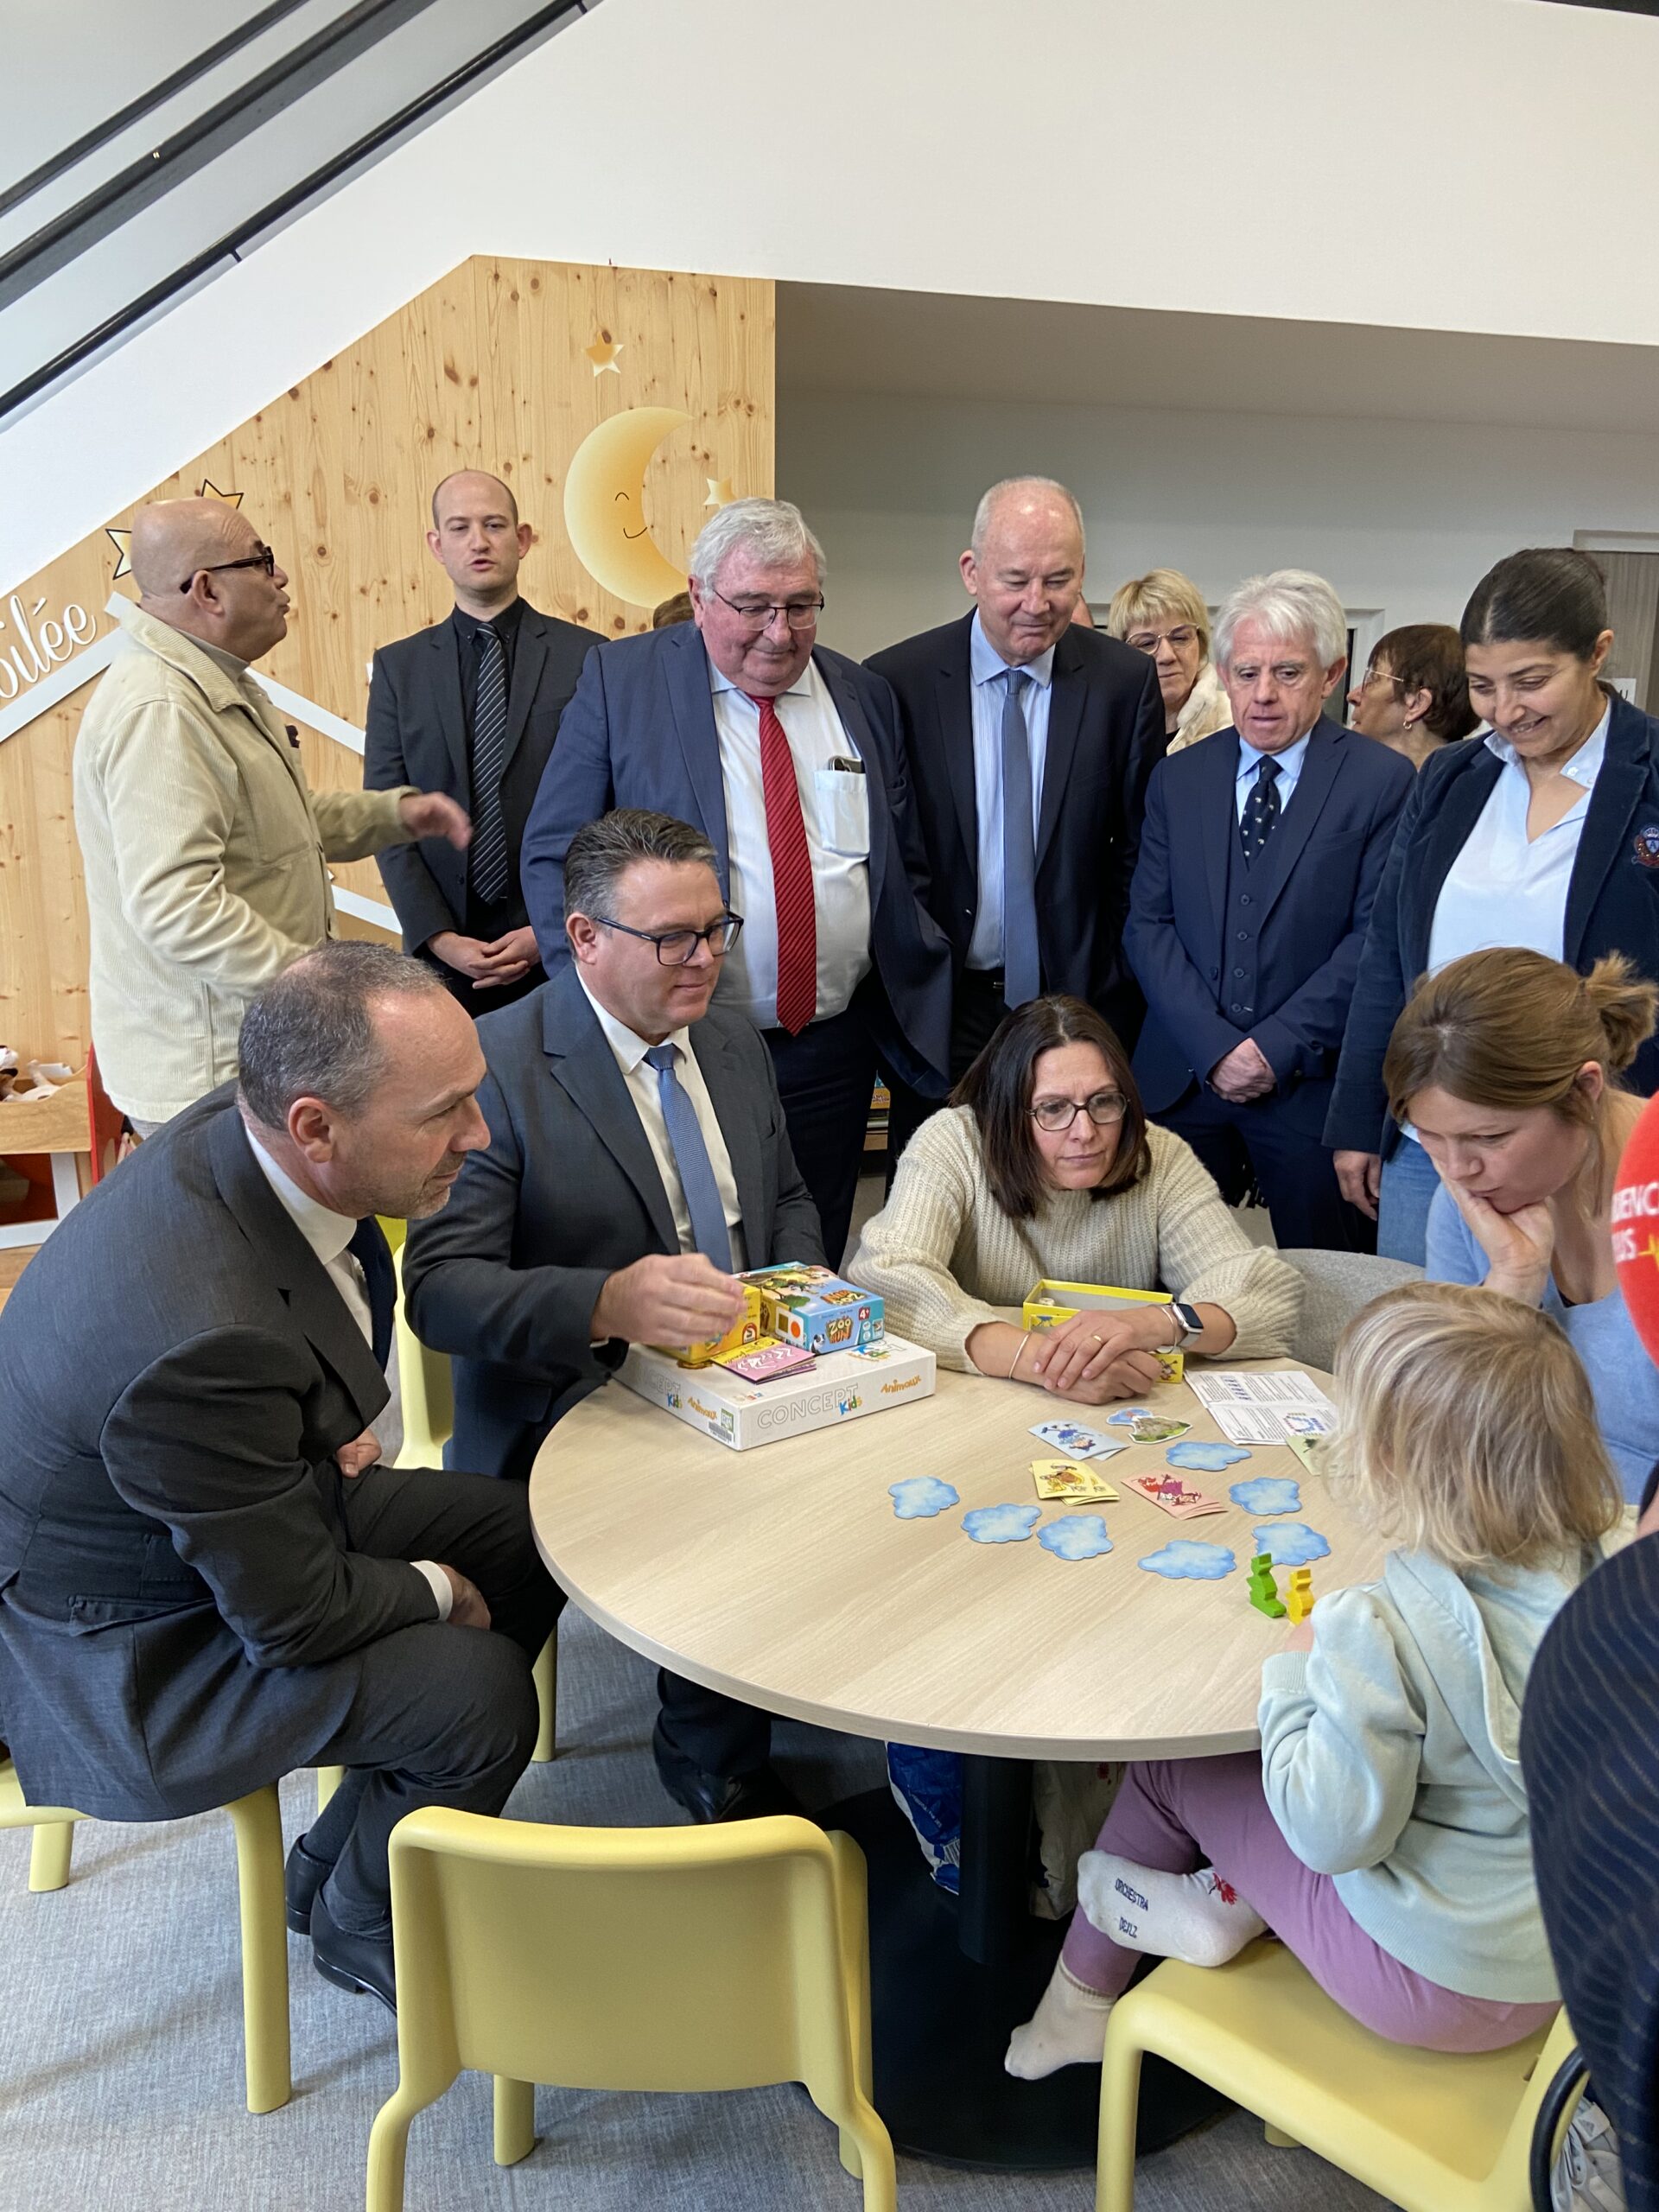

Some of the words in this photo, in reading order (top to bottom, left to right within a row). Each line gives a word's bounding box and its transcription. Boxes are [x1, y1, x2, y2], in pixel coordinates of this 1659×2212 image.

[828, 1318, 852, 1336] ZOO
[880, 1375, 922, 1394] Animaux
[757, 1383, 859, 1428] CONCEPT
[839, 1395, 862, 1415] Kids
[1115, 1878, 1148, 1911] ORCHESTRA
